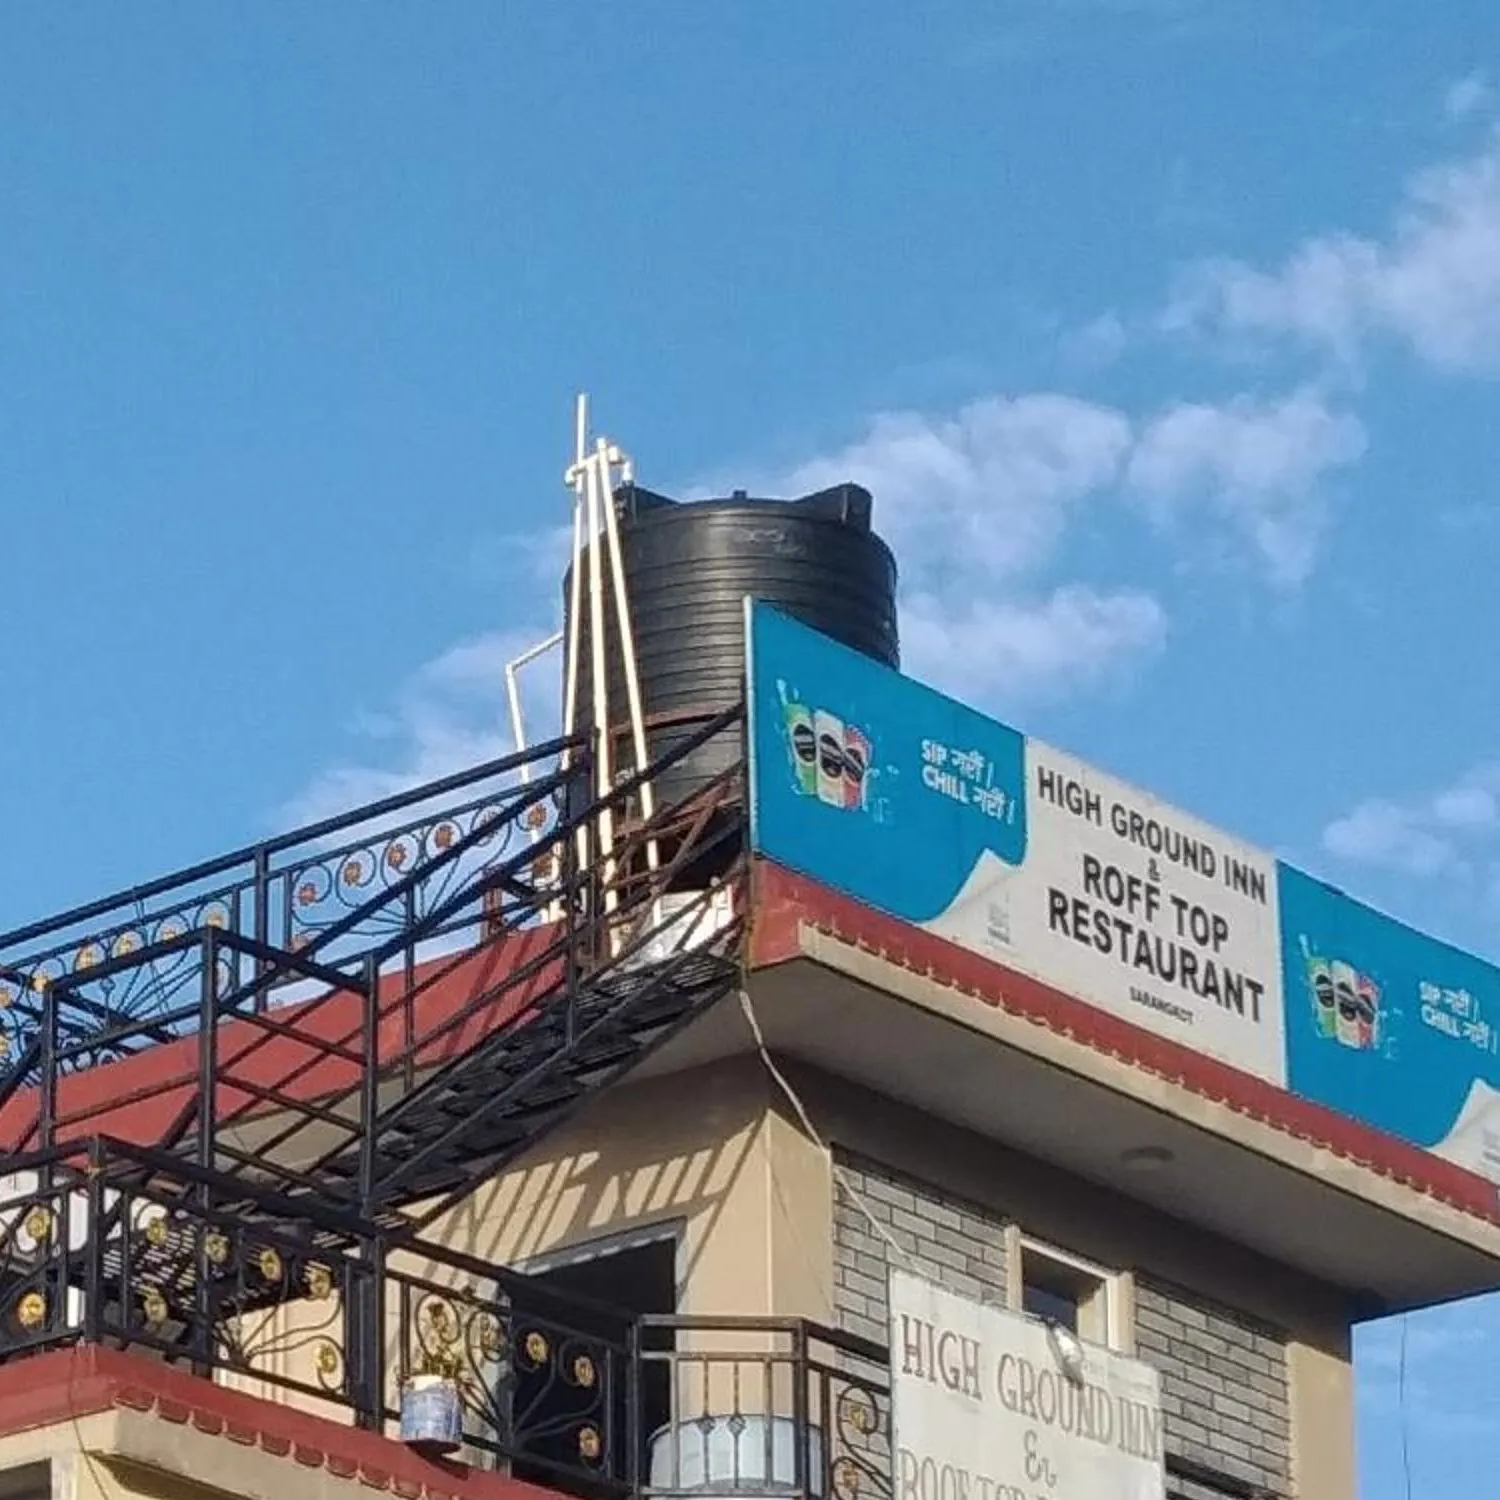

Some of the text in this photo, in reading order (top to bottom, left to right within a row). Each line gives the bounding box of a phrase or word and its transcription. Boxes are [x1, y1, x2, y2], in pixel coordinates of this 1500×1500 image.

[921, 739, 947, 766] SIP
[922, 765, 970, 805] CHILL
[1037, 765, 1267, 905] HIGH GROUND INN
[1148, 857, 1161, 882] &
[1083, 853, 1229, 953] ROFF TOP
[1048, 887, 1264, 1023] RESTAURANT
[1421, 1005, 1460, 1038] CHILL
[900, 1313, 1164, 1461] HIGH GROUND INN
